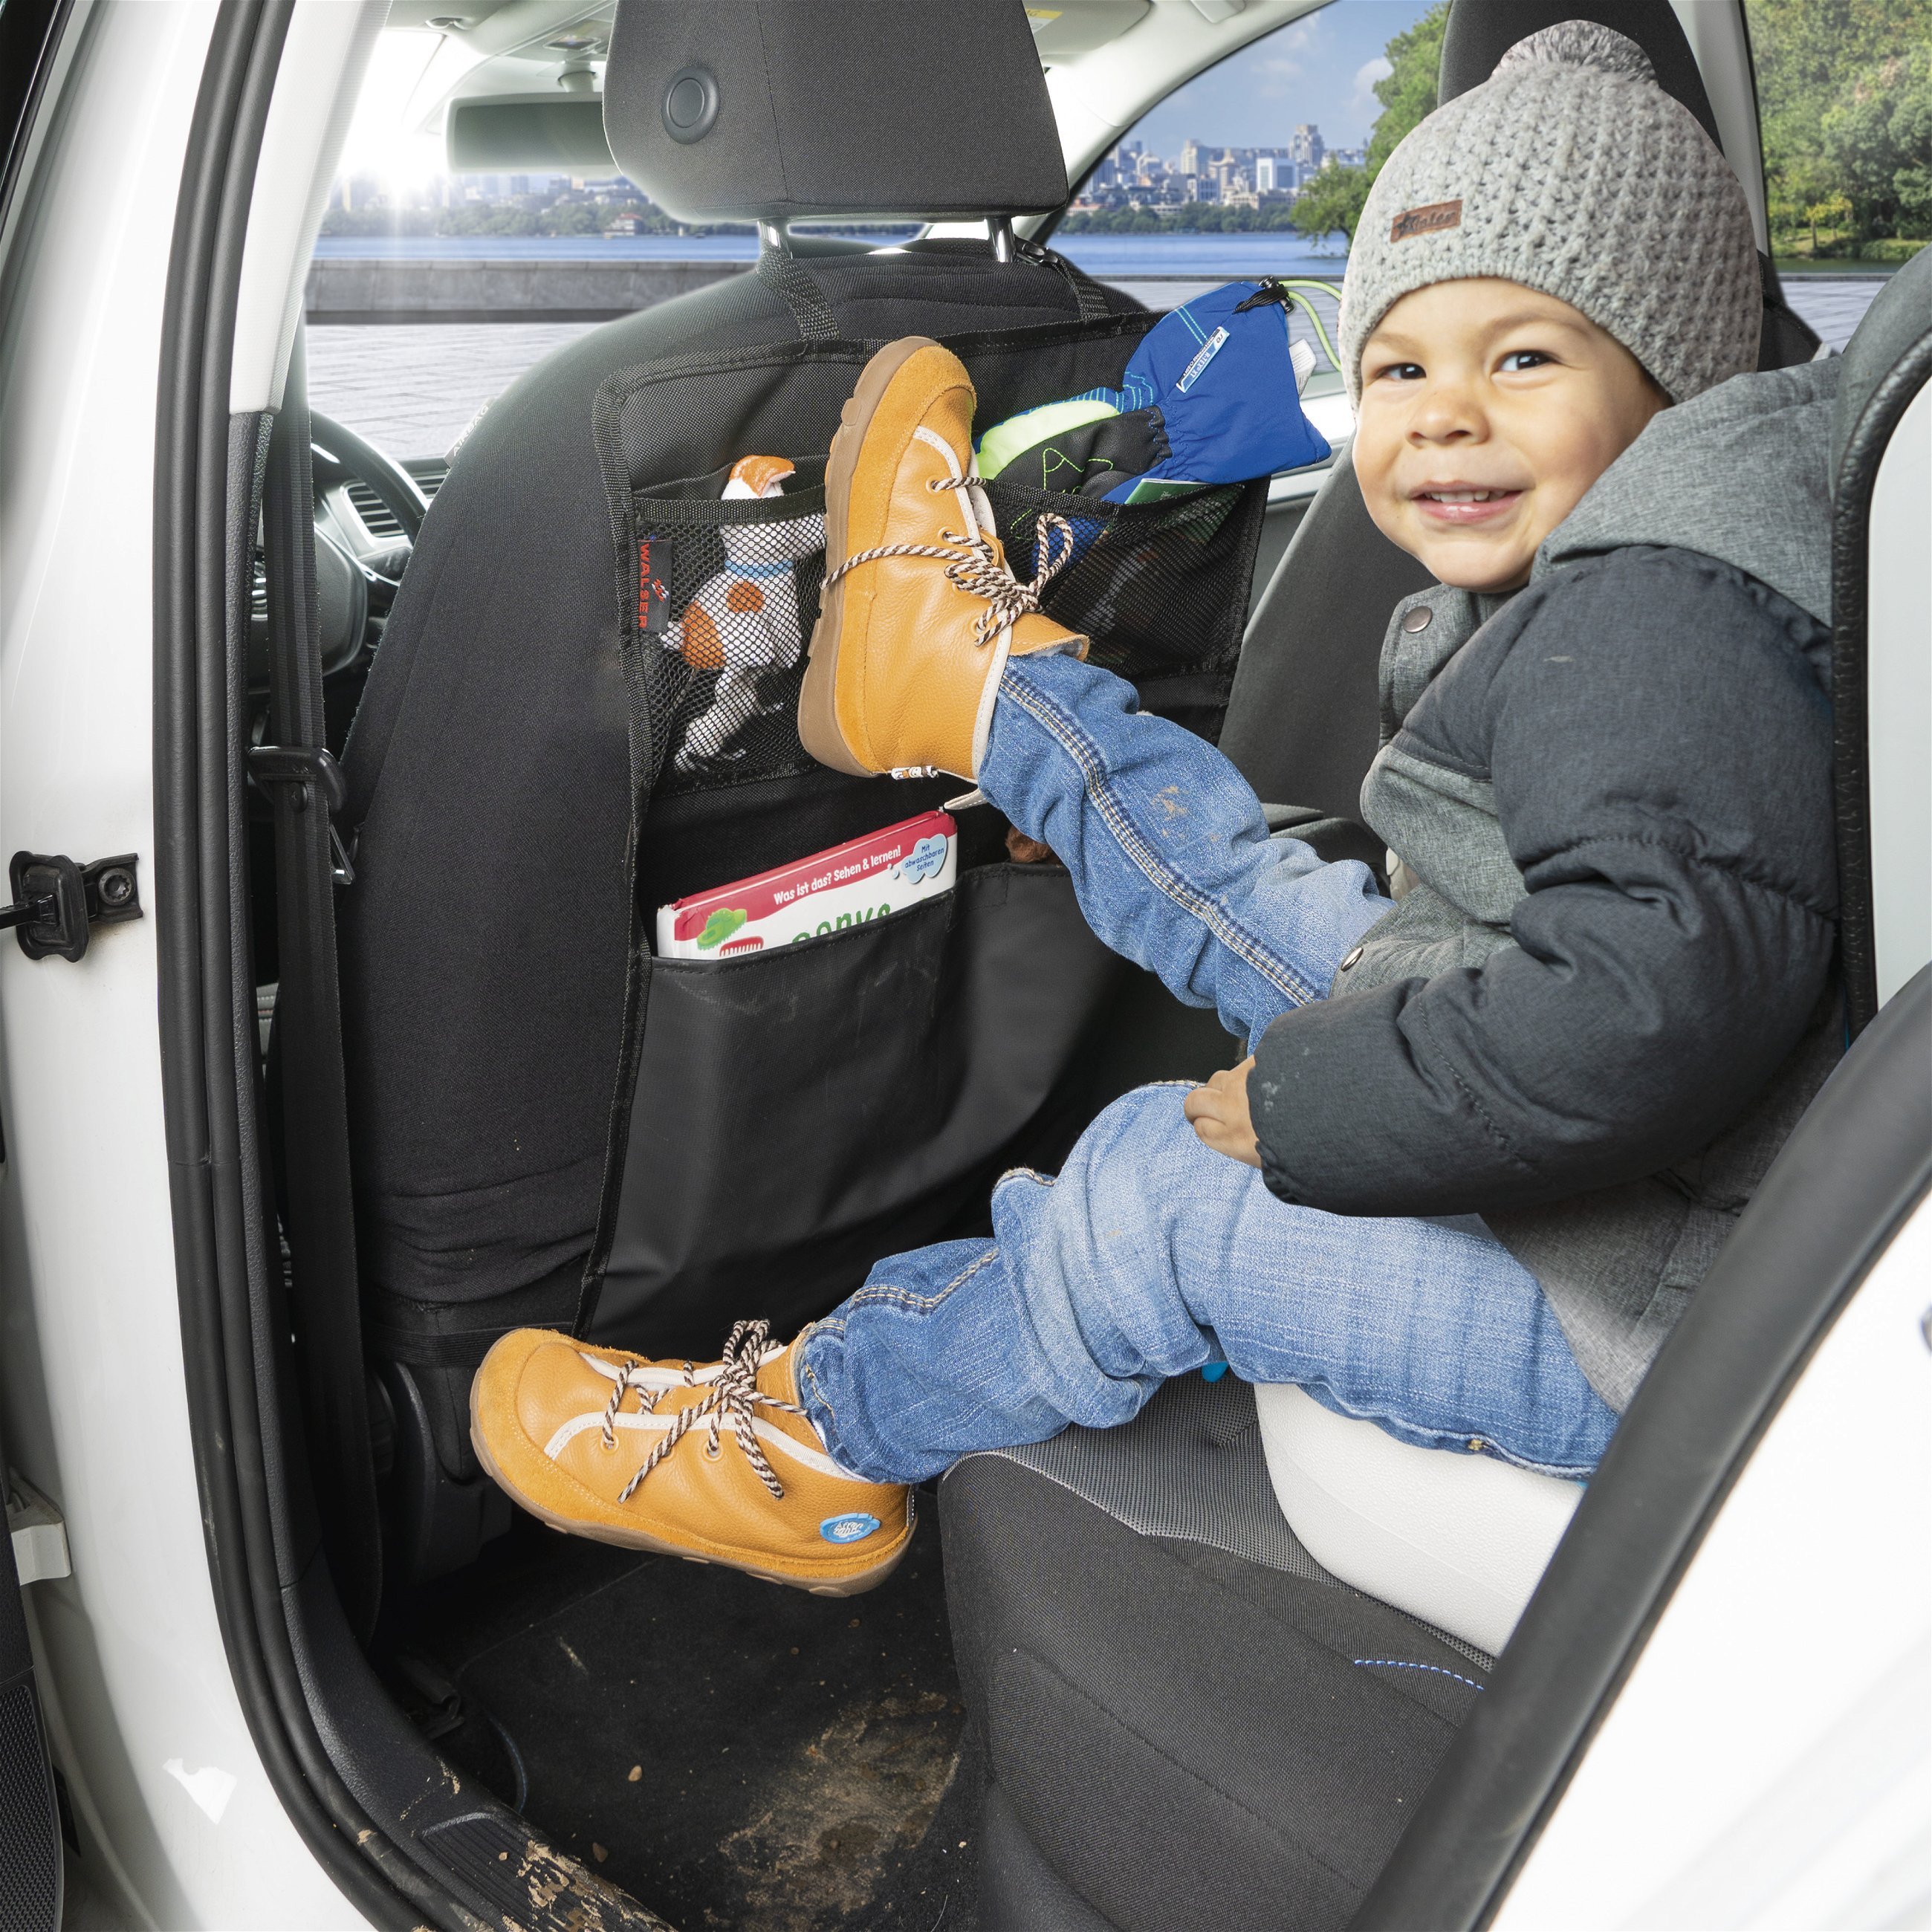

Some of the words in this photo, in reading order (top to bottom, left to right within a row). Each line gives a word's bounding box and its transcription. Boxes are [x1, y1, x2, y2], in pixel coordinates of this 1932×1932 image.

[638, 543, 650, 629] WALSER
[904, 847, 944, 869] abwaschbaren
[921, 844, 930, 853] Mit
[774, 889, 794, 905] Was
[797, 882, 809, 896] ist
[811, 872, 832, 892] das?
[834, 863, 862, 882] Sehen
[863, 858, 870, 870] &
[871, 845, 901, 866] lernen!
[916, 860, 935, 872] Seiten
